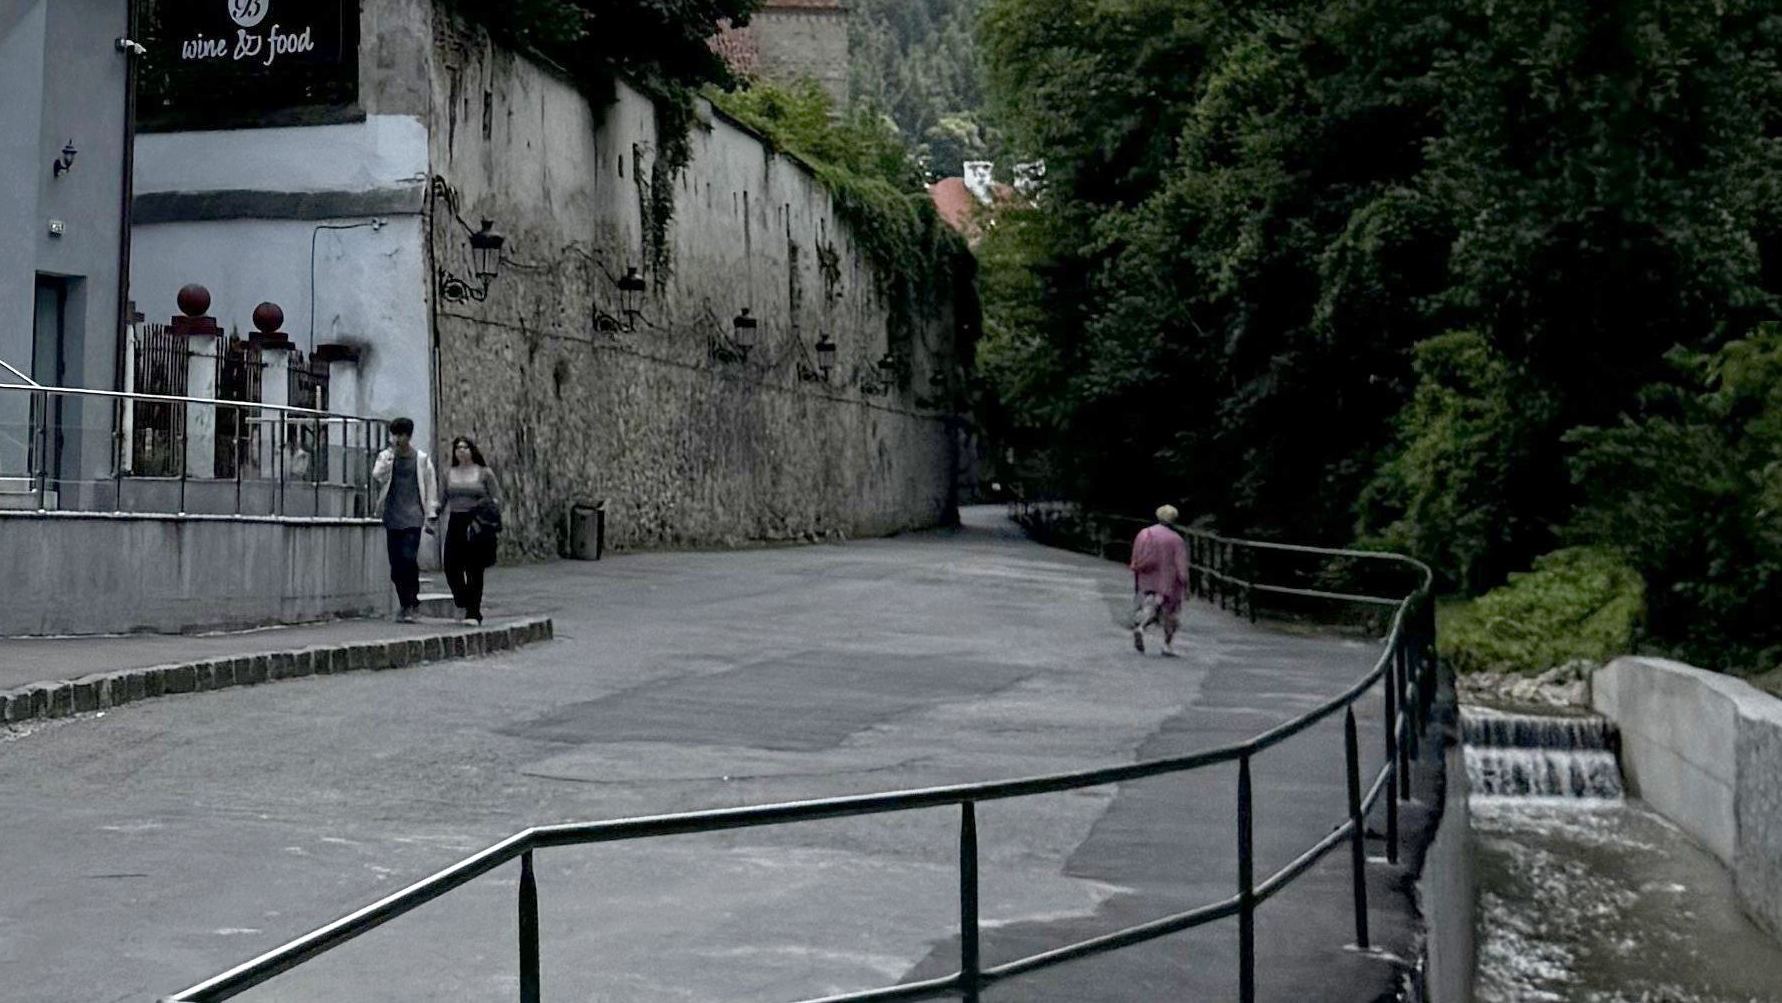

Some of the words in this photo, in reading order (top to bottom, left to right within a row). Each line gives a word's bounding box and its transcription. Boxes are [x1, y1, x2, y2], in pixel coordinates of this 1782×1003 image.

[181, 32, 228, 60] wine
[233, 28, 263, 61] &
[263, 23, 315, 66] food
